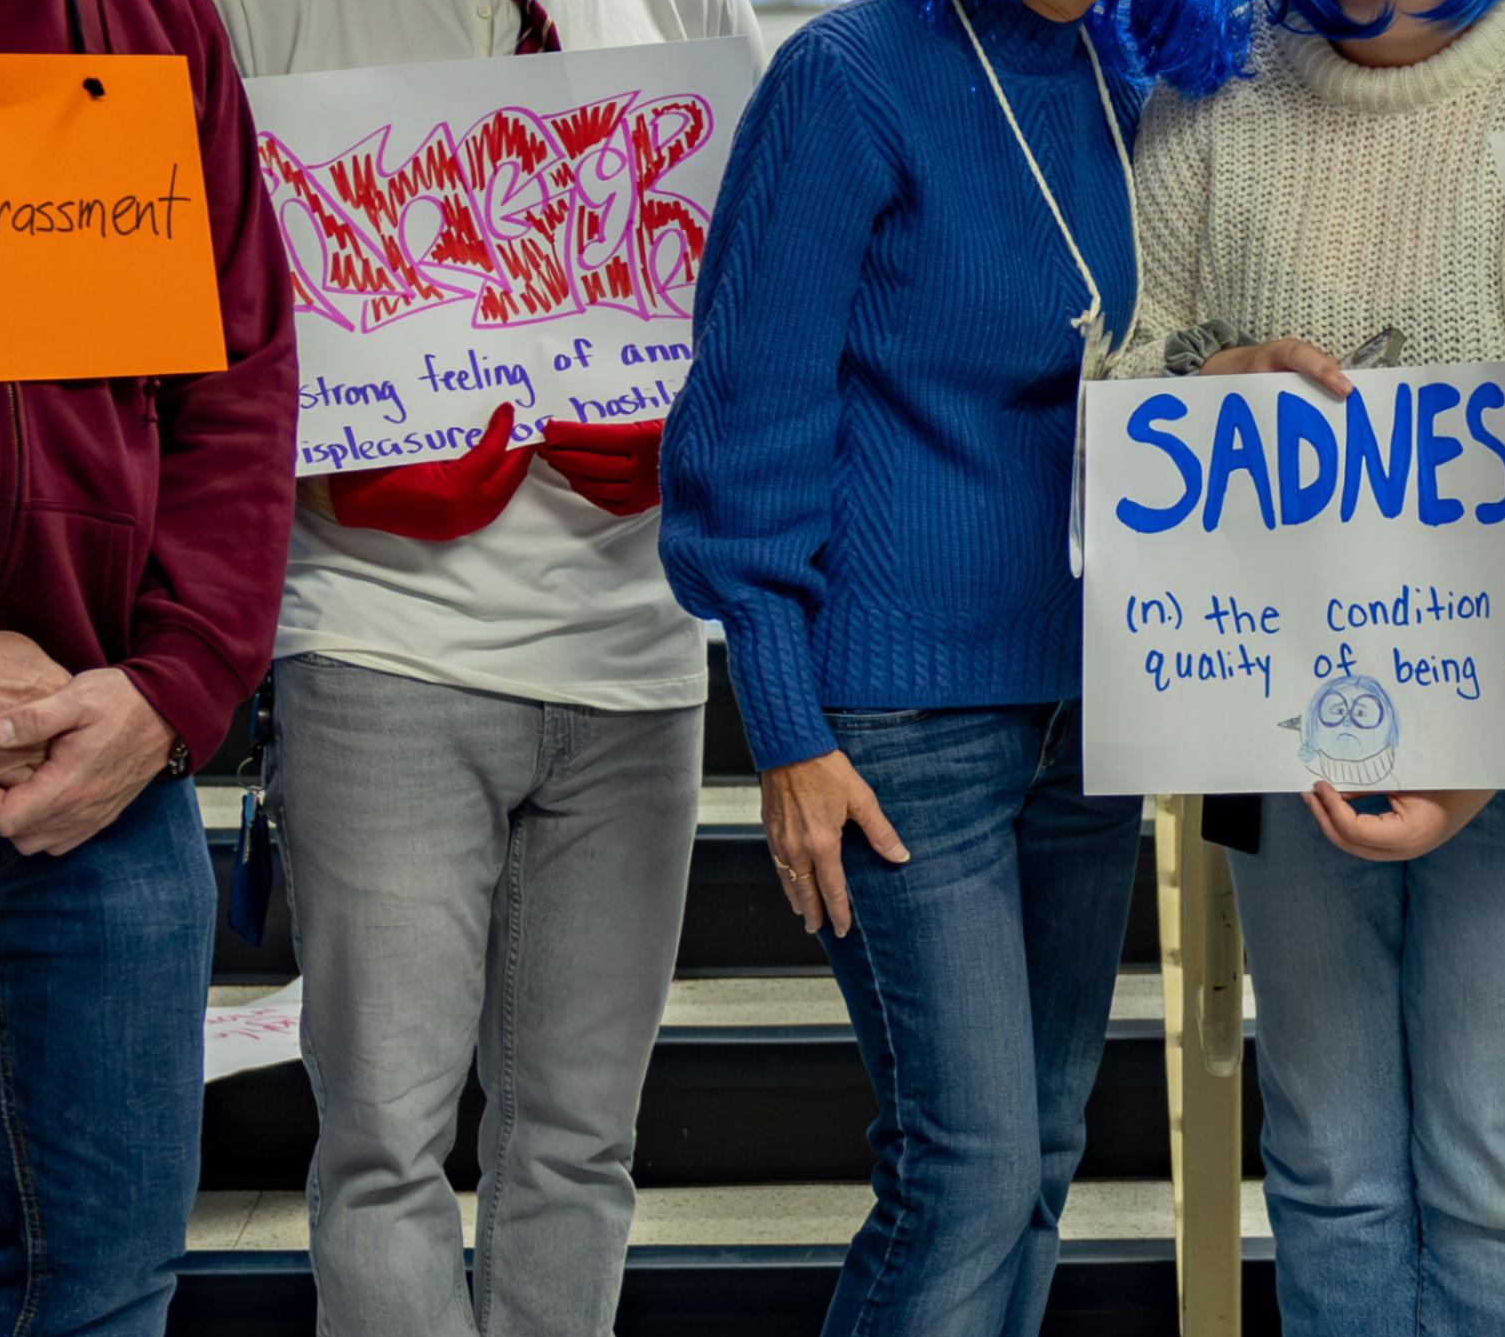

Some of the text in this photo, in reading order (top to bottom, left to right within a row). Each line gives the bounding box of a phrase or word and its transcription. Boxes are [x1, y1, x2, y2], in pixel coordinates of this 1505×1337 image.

[298, 375, 409, 424] strong
[418, 349, 537, 408] feeling
[553, 336, 594, 373] of
[296, 425, 484, 471] ispleasure
[1204, 595, 1281, 635] the
[1327, 584, 1490, 632] condition
[1144, 643, 1271, 698] quality
[1313, 642, 1357, 678] of
[1393, 647, 1481, 700] being
